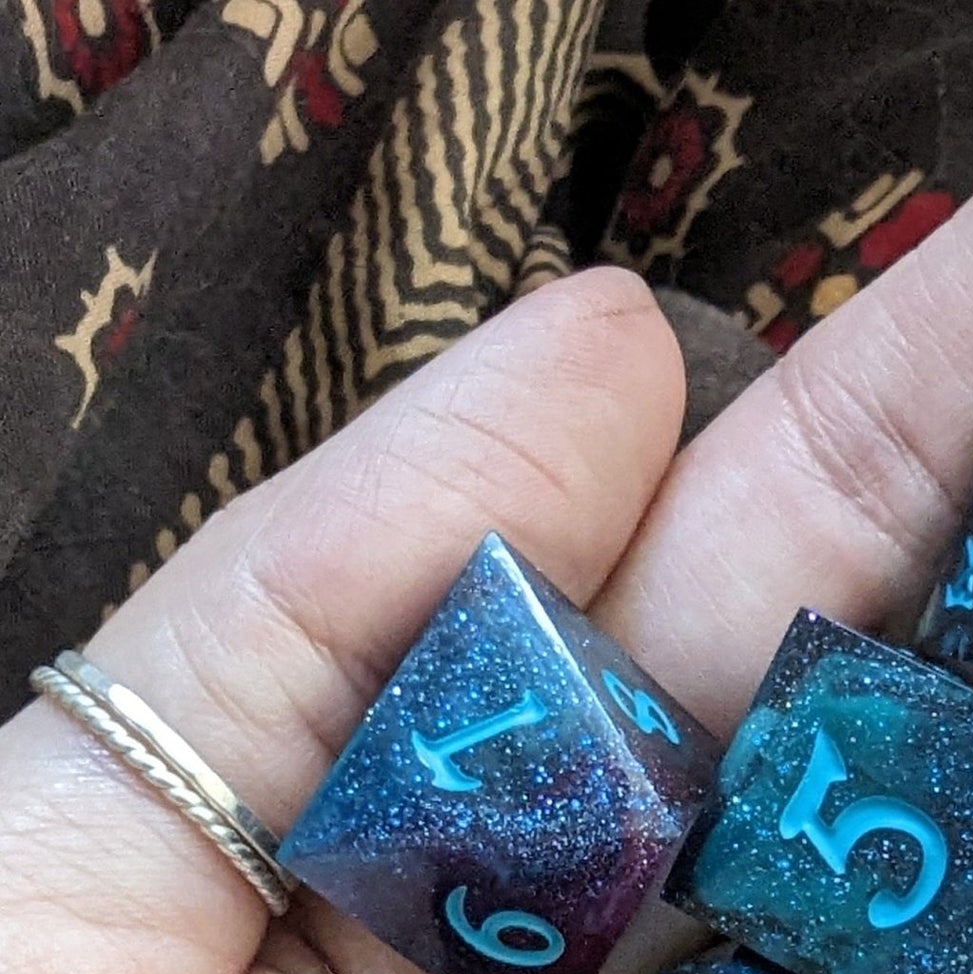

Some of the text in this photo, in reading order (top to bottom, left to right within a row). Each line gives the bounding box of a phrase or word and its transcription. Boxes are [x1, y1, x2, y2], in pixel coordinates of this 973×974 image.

[412, 690, 547, 791] 1
[780, 730, 947, 928] 5
[445, 885, 565, 966] 6
